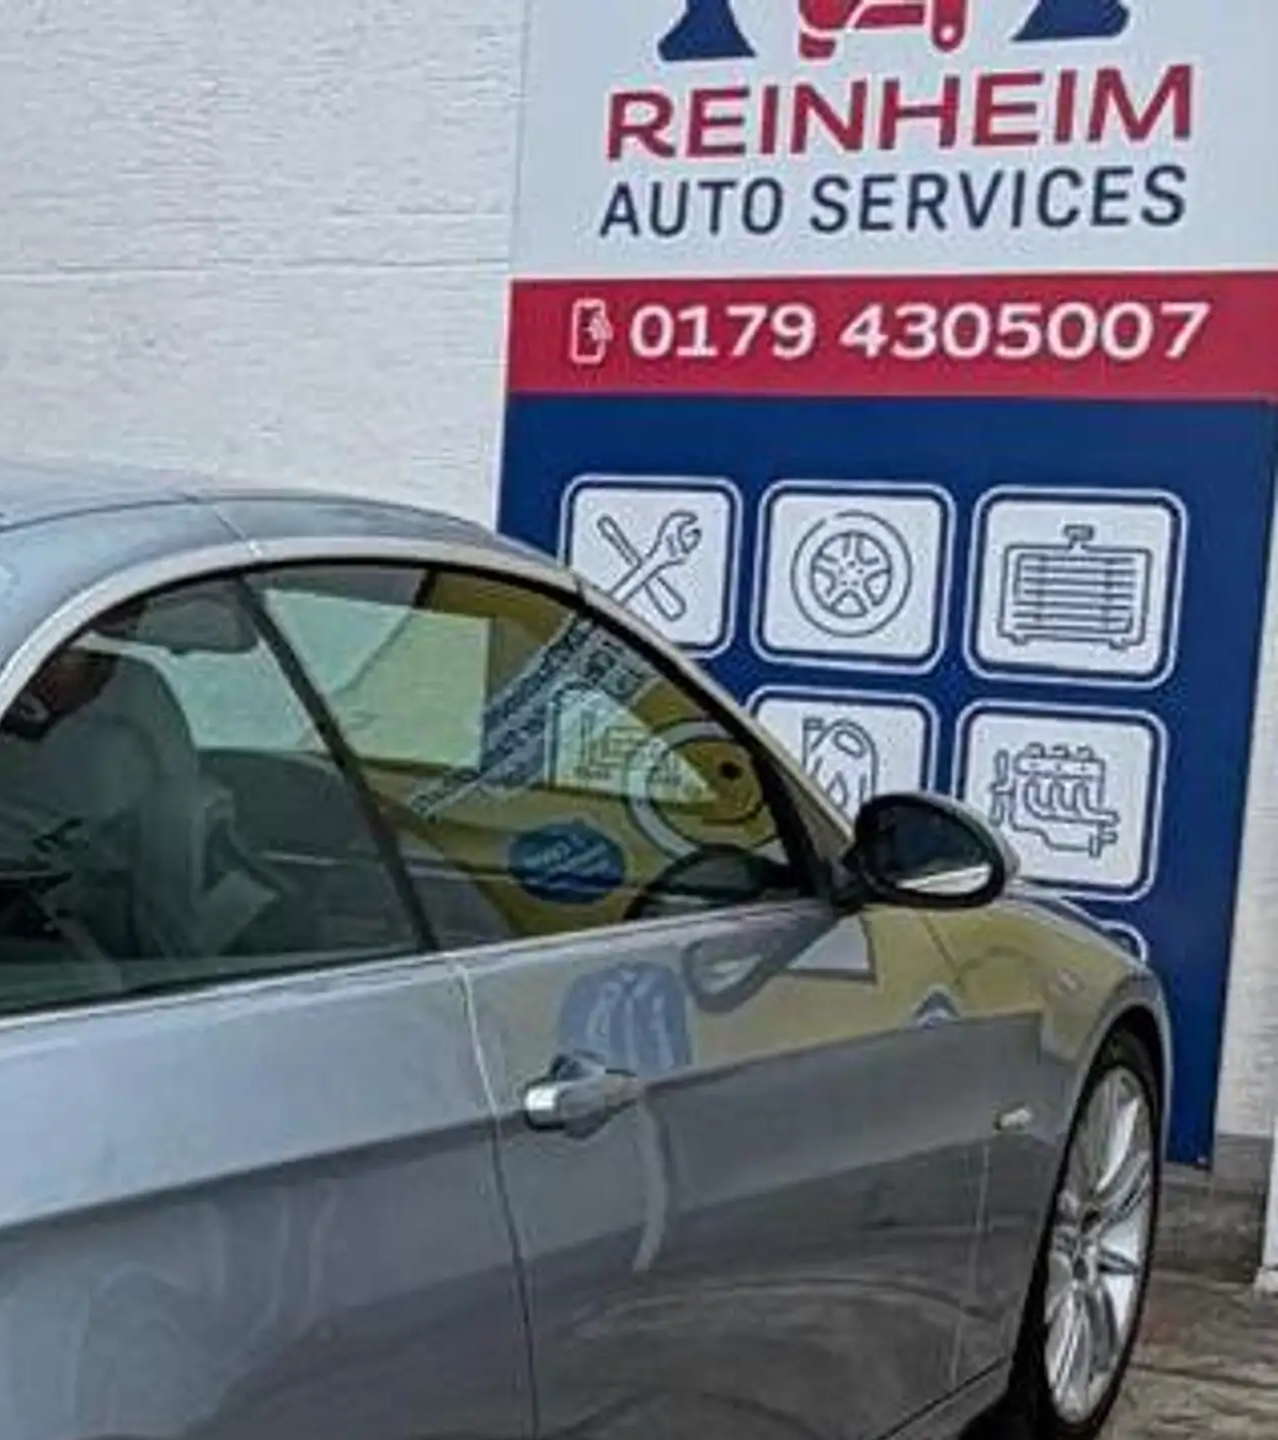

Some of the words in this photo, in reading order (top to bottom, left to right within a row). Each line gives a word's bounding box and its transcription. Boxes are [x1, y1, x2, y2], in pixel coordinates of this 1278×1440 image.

[607, 64, 1192, 161] REINHEIM
[599, 176, 784, 239] AUTO
[809, 164, 1188, 233] SERVICES
[629, 303, 817, 360] 0179
[838, 301, 1212, 361] 4305007
